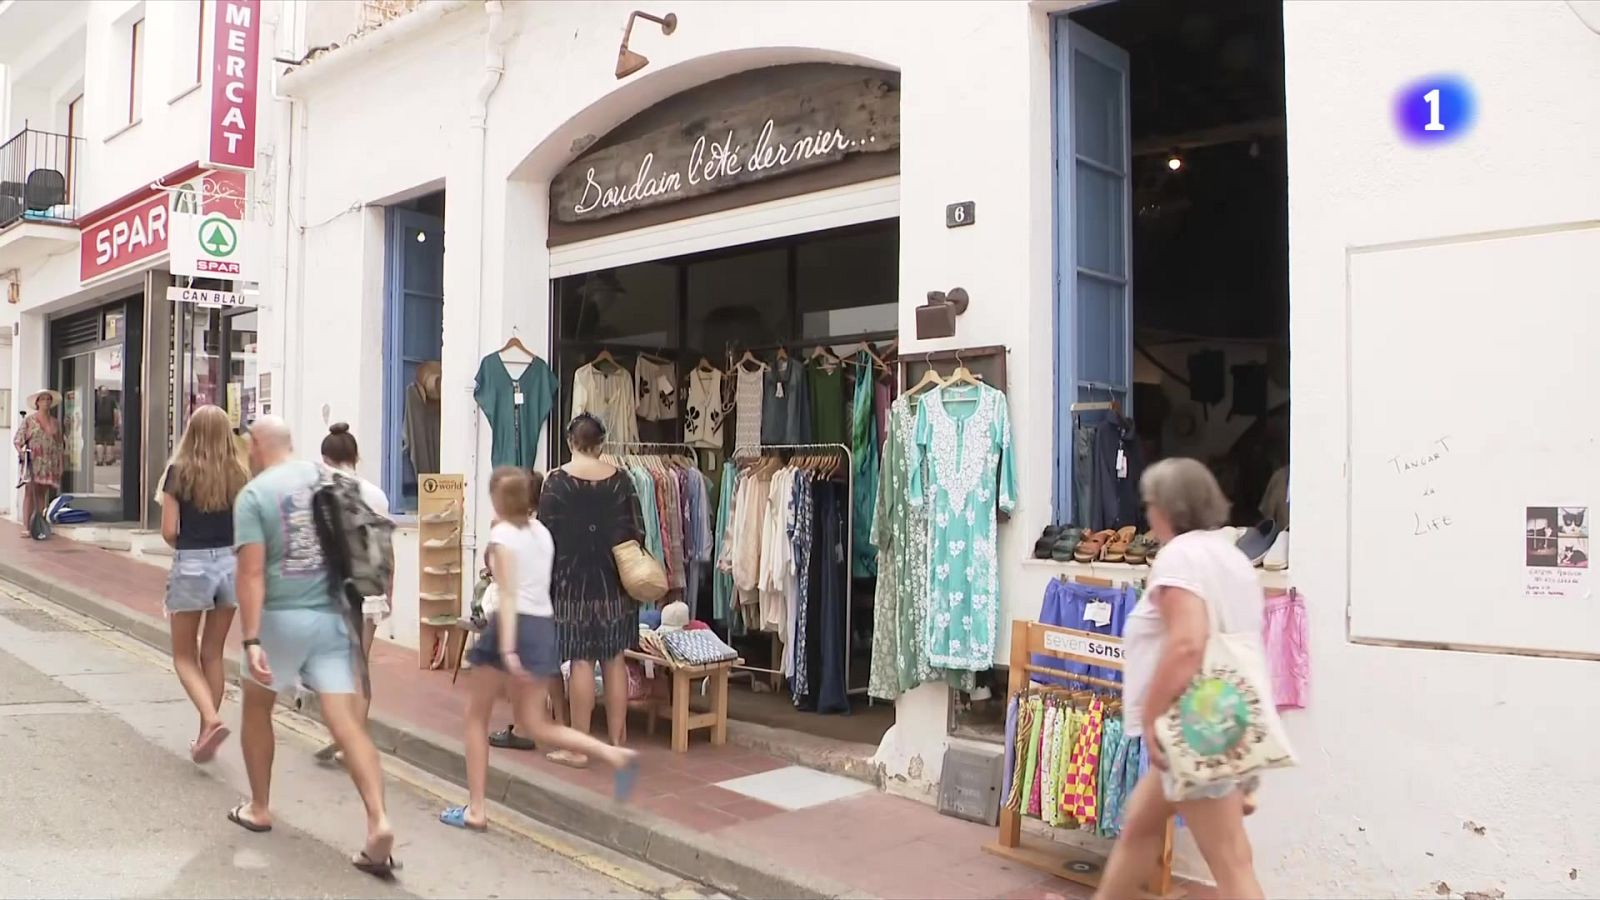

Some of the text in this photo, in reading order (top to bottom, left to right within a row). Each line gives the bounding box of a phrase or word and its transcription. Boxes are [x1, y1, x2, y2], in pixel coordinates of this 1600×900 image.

[574, 152, 681, 214] Soudain
[954, 206, 965, 223] 6
[96, 205, 166, 265] SPAR
[197, 261, 239, 273] SPAR
[183, 290, 246, 305] CAN BLAU
[439, 482, 462, 490] world
